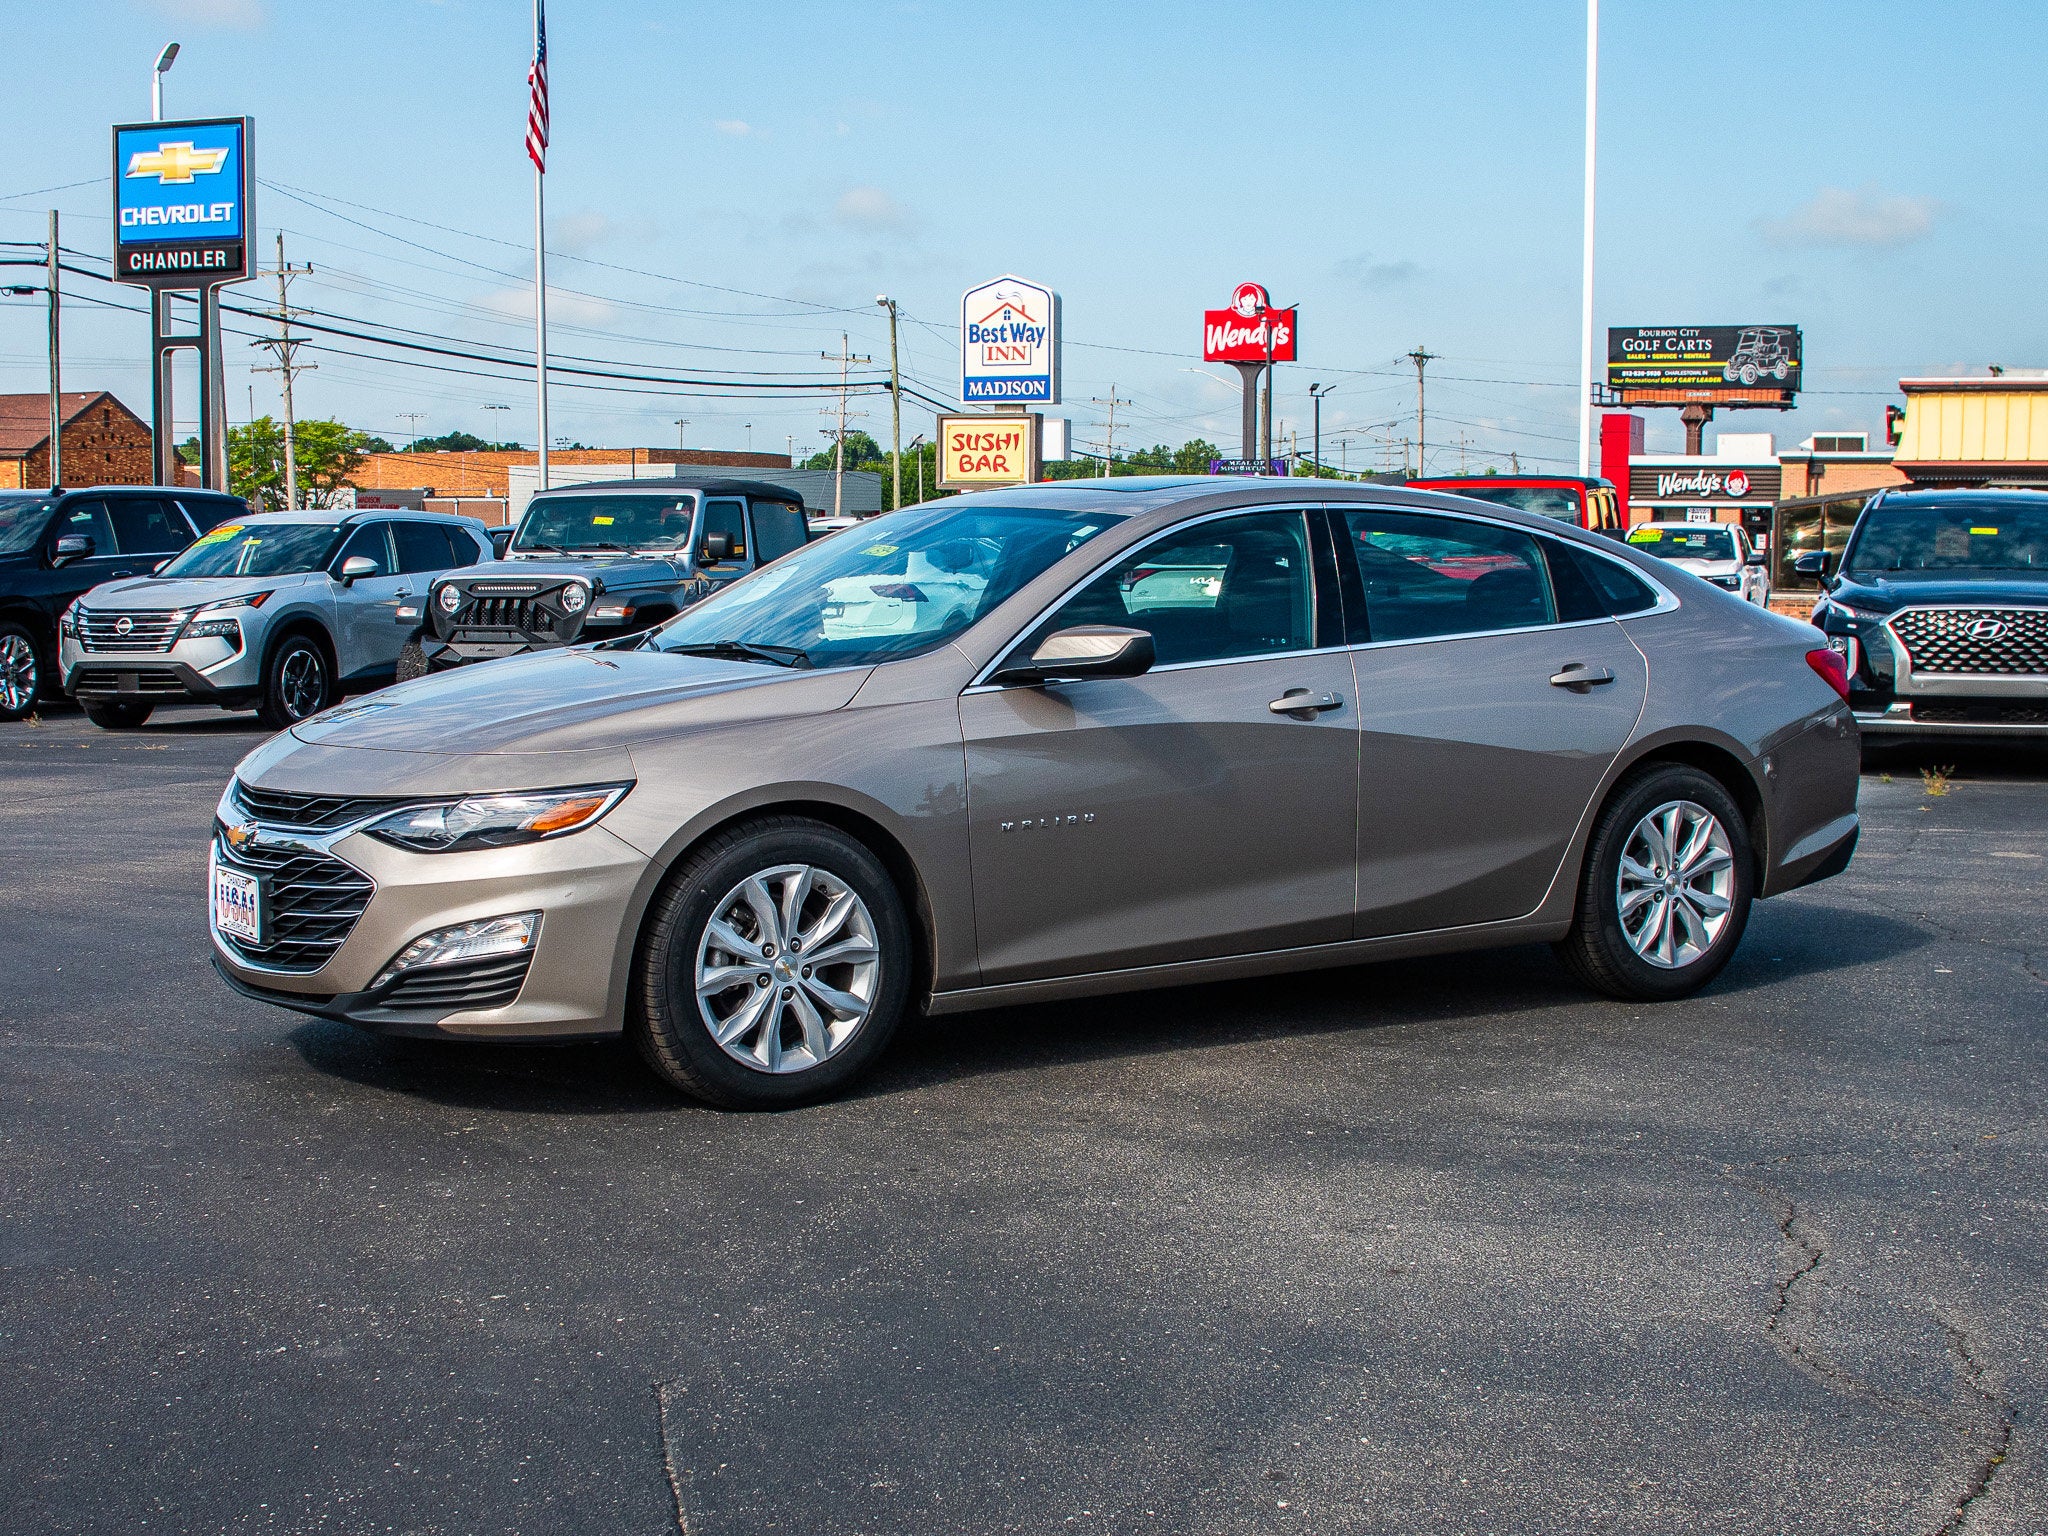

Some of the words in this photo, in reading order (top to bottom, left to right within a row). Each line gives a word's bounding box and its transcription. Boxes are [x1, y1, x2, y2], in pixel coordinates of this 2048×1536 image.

[121, 203, 234, 226] CHEVROLET
[130, 250, 226, 270] CHANDLER
[968, 323, 1007, 344] Best
[1010, 323, 1046, 349] Way
[1207, 317, 1290, 354] Wendy's
[1638, 329, 1677, 337] BOURBON
[1680, 328, 1700, 337] CITY
[986, 346, 1027, 361] INN
[1622, 338, 1660, 351] GOLF
[1665, 338, 1713, 351] CARTS
[968, 380, 1046, 396] MADISON
[952, 433, 1020, 451] SUSHI
[958, 454, 1010, 473] BAR
[1657, 470, 1722, 497] Wendy's
[1001, 813, 1095, 832] MALIBU
